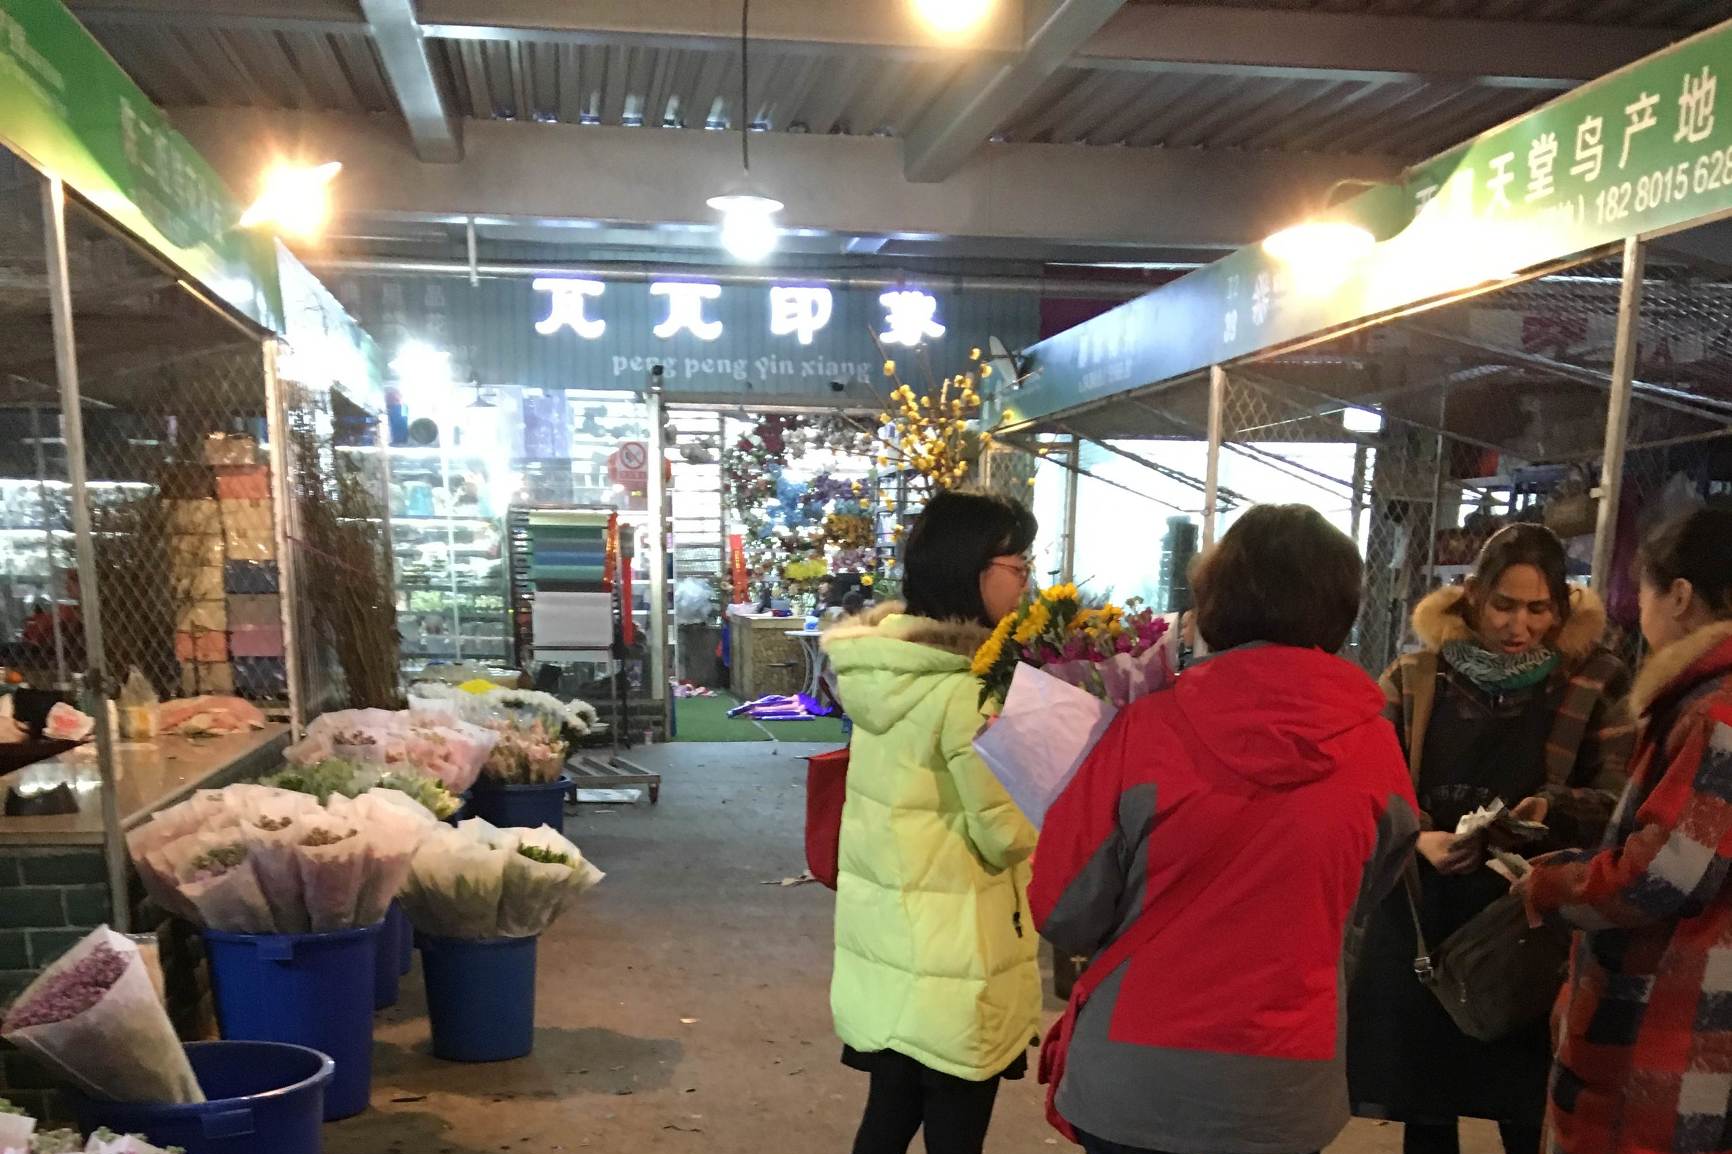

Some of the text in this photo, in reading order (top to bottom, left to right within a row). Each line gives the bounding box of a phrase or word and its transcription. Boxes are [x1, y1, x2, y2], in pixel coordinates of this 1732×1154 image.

[1596, 182, 1633, 224] 182
[1634, 161, 1690, 212] 8015
[685, 357, 748, 380] peng
[801, 356, 872, 384] xiang
